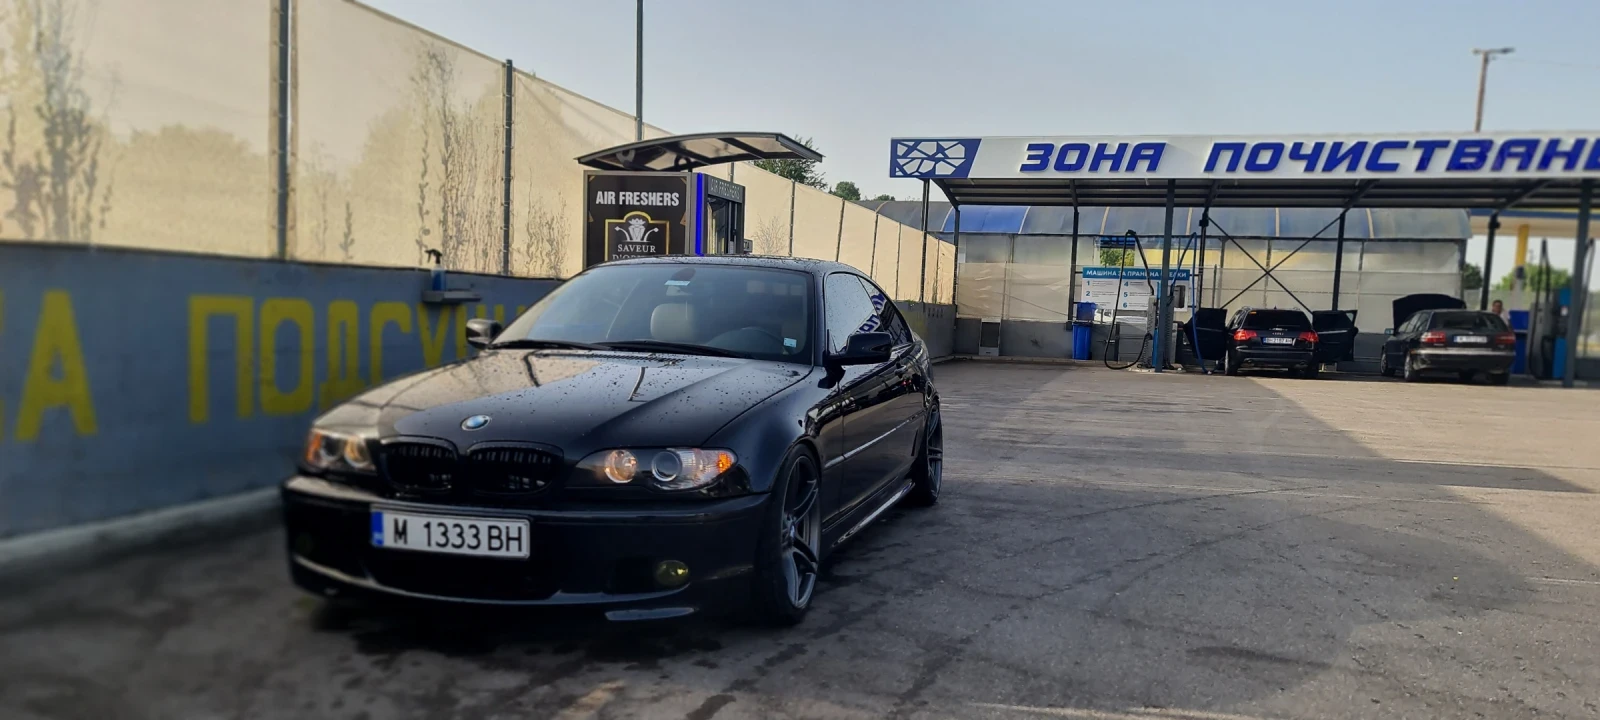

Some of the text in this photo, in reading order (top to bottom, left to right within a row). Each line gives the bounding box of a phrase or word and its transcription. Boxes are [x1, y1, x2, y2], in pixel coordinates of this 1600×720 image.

[1019, 142, 1167, 173] ЗОНА
[595, 190, 680, 207] AIR FRESHERS
[617, 243, 656, 253] SAVEUR
[393, 517, 522, 552] M 1333 BH
